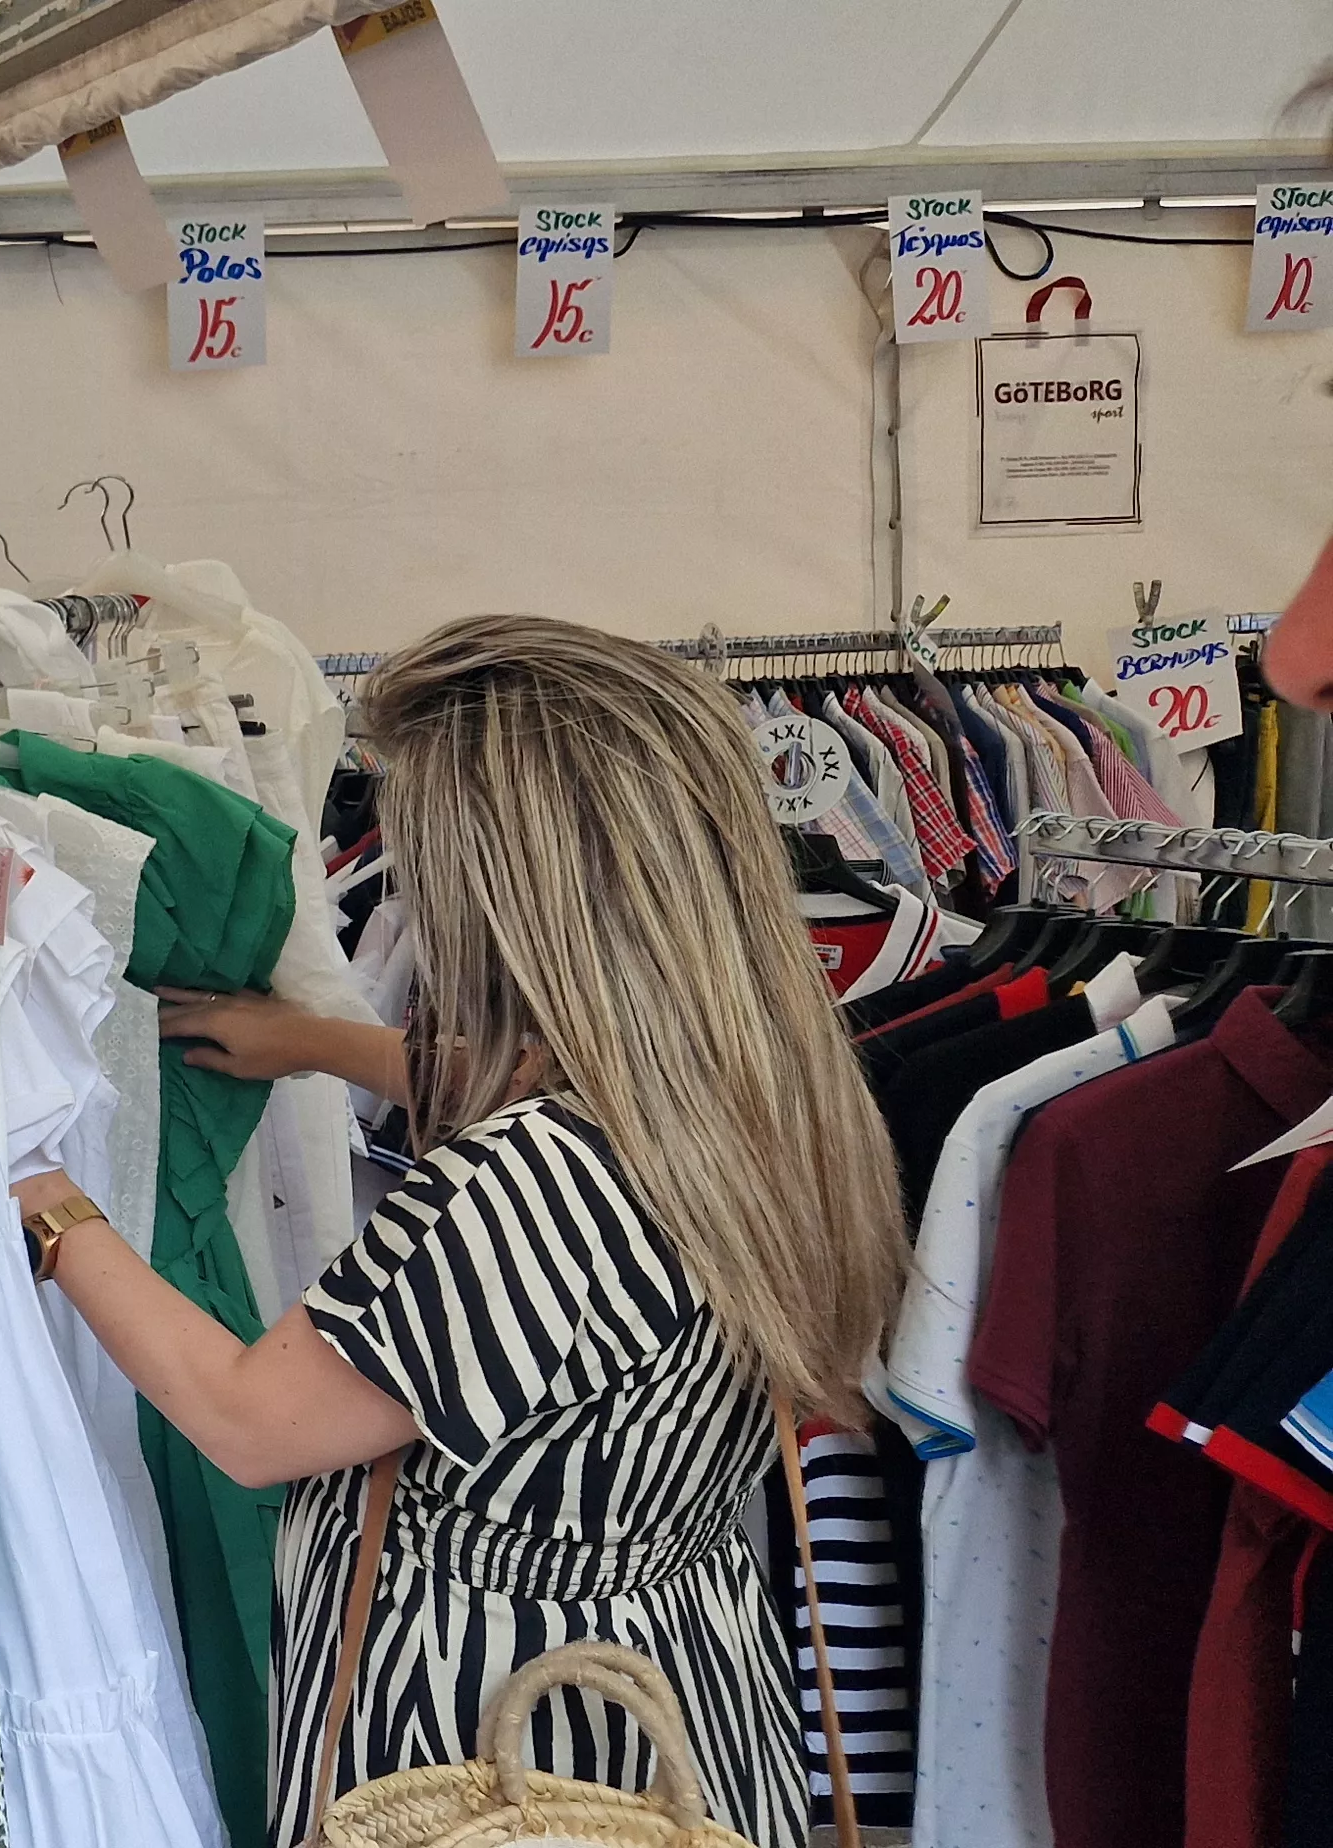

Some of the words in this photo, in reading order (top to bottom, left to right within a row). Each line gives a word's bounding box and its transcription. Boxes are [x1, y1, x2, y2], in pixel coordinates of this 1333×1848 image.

[906, 197, 973, 220] STOCK
[1270, 187, 1333, 211] STOCK
[535, 209, 603, 232] STOCK
[180, 223, 247, 246] STOCK
[1090, 405, 1124, 424] sport
[1131, 618, 1208, 648] STOCK
[768, 723, 806, 743] XXL
[818, 745, 840, 782] XXL
